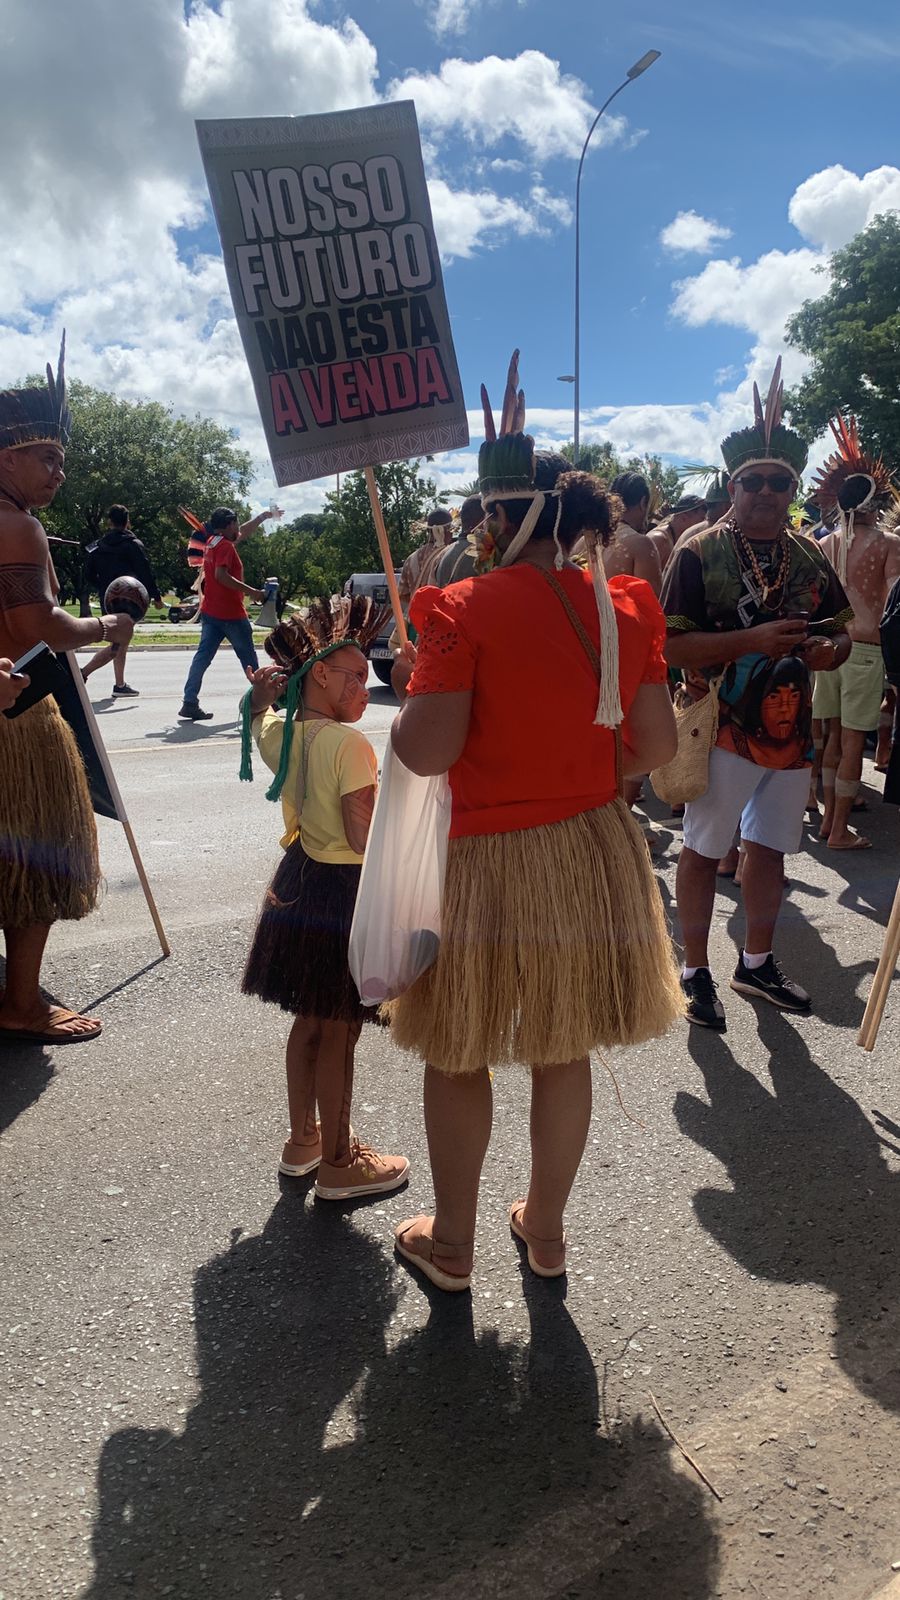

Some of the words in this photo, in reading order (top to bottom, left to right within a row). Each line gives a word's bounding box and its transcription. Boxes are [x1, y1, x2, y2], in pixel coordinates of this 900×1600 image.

[232, 154, 410, 242] NOSSO
[234, 222, 436, 316] FUTURO
[299, 346, 454, 428] VENDA
